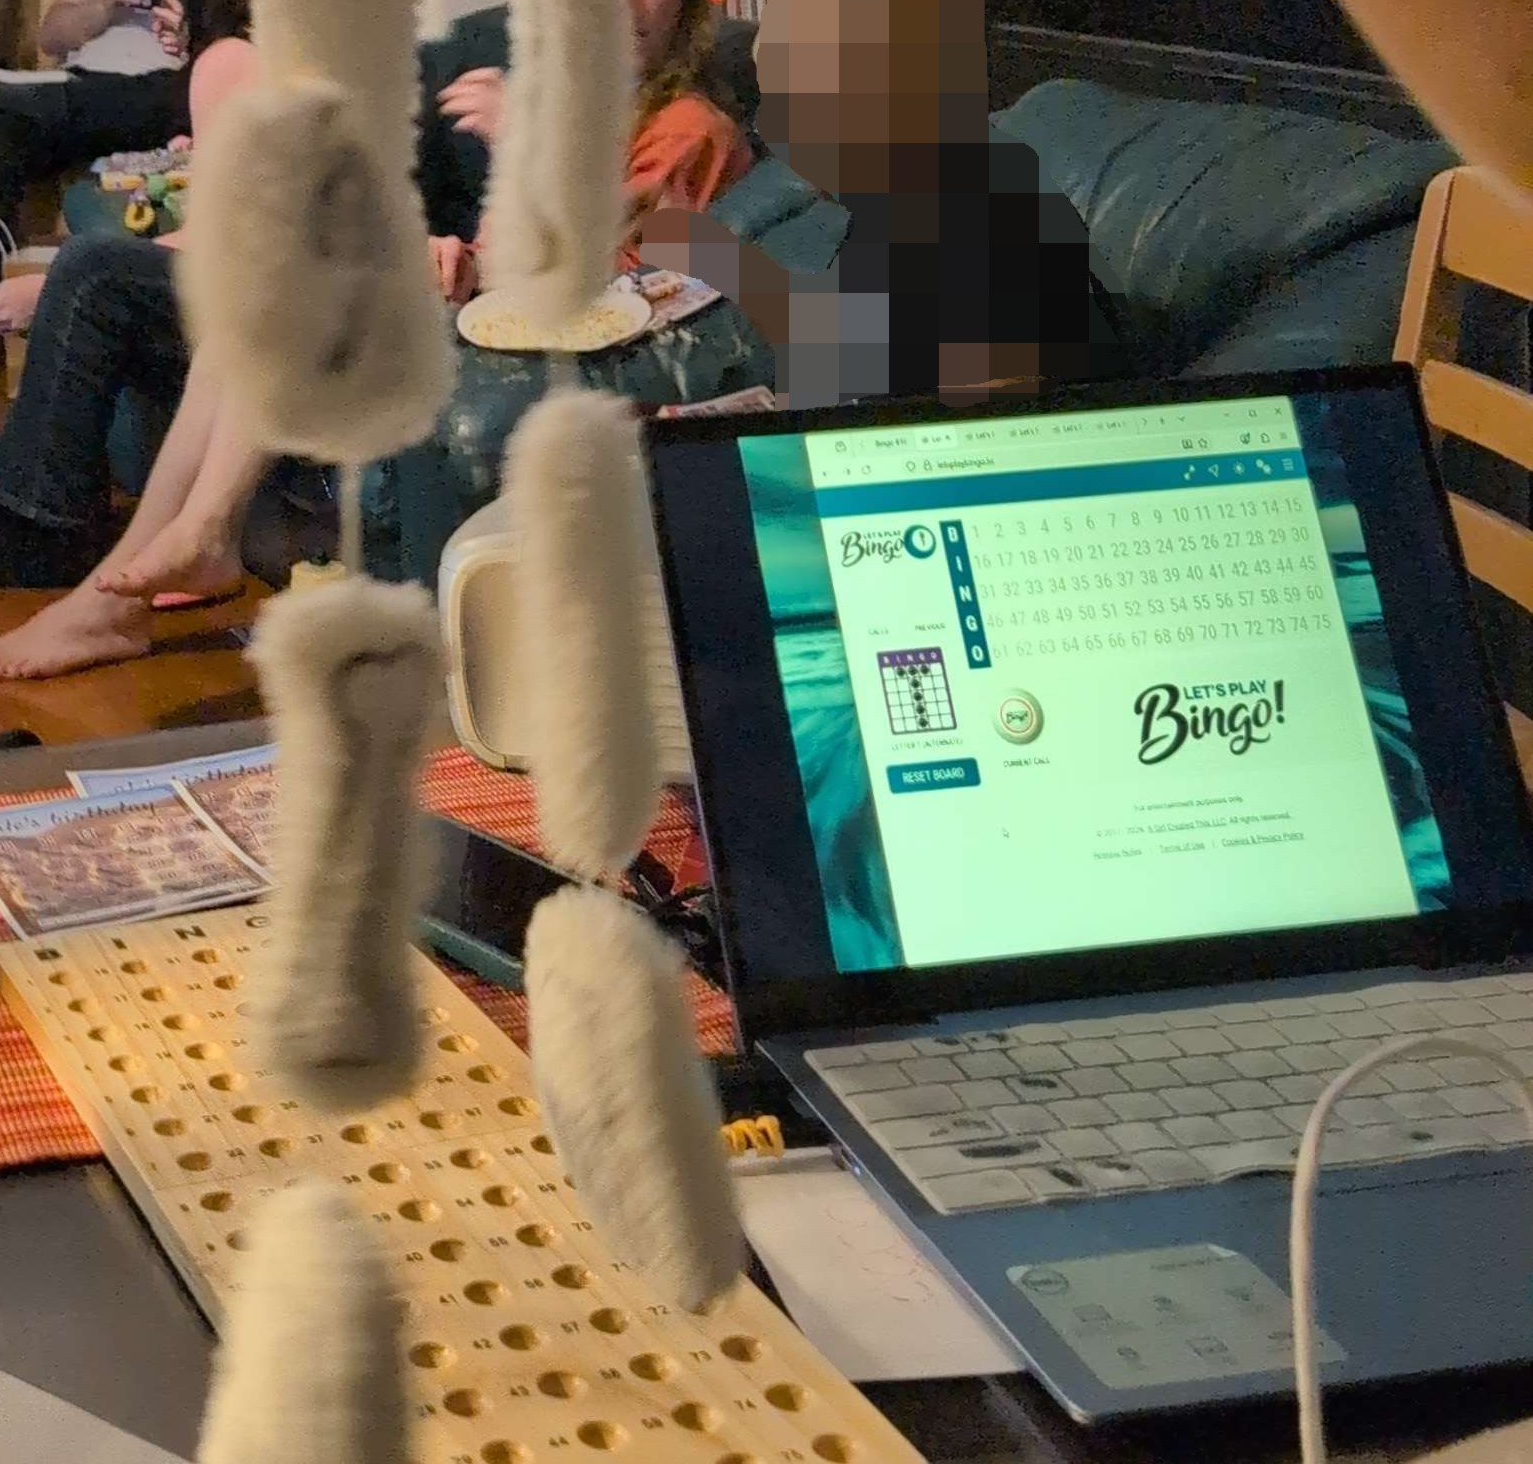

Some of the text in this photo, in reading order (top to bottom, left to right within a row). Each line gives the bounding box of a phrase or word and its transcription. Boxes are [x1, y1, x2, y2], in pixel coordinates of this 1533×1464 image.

[994, 522, 1004, 538] 2
[1016, 520, 1027, 536] 3
[1041, 518, 1049, 534] 4
[1063, 516, 1073, 532] 5
[1086, 515, 1095, 530] 6
[1107, 512, 1116, 528] 7
[1131, 511, 1141, 527] 8
[1153, 509, 1163, 524] 9
[1173, 507, 1189, 522] 10
[1194, 505, 1211, 520] 11
[1217, 503, 1236, 519] 12
[1239, 500, 1257, 517] 13
[1261, 499, 1280, 516] 14
[1285, 497, 1303, 513] 15
[973, 526, 1309, 571] 16 17 18 19 20 21 22 23 24 25 26 27 28 29 30
[979, 555, 1318, 601] 31 32 33 34 35 36 37 38 39 40 41 42 43 44 45
[986, 582, 1324, 631] 46 47 48 49 50 51 52 53 54 55 56 57 58 59 60
[992, 614, 1332, 661] 61 62 63 64 65 66 67 68 69 70 71 72 73 74 75
[1183, 679, 1267, 700] LET'S PLAY
[1134, 679, 1285, 765] Bingo!
[902, 766, 965, 784] RESET BOARD
[174, 925, 207, 940] N
[571, 1220, 593, 1233] 70
[646, 1304, 670, 1316] 72
[688, 1349, 713, 1364] 73
[733, 1398, 757, 1411] 74
